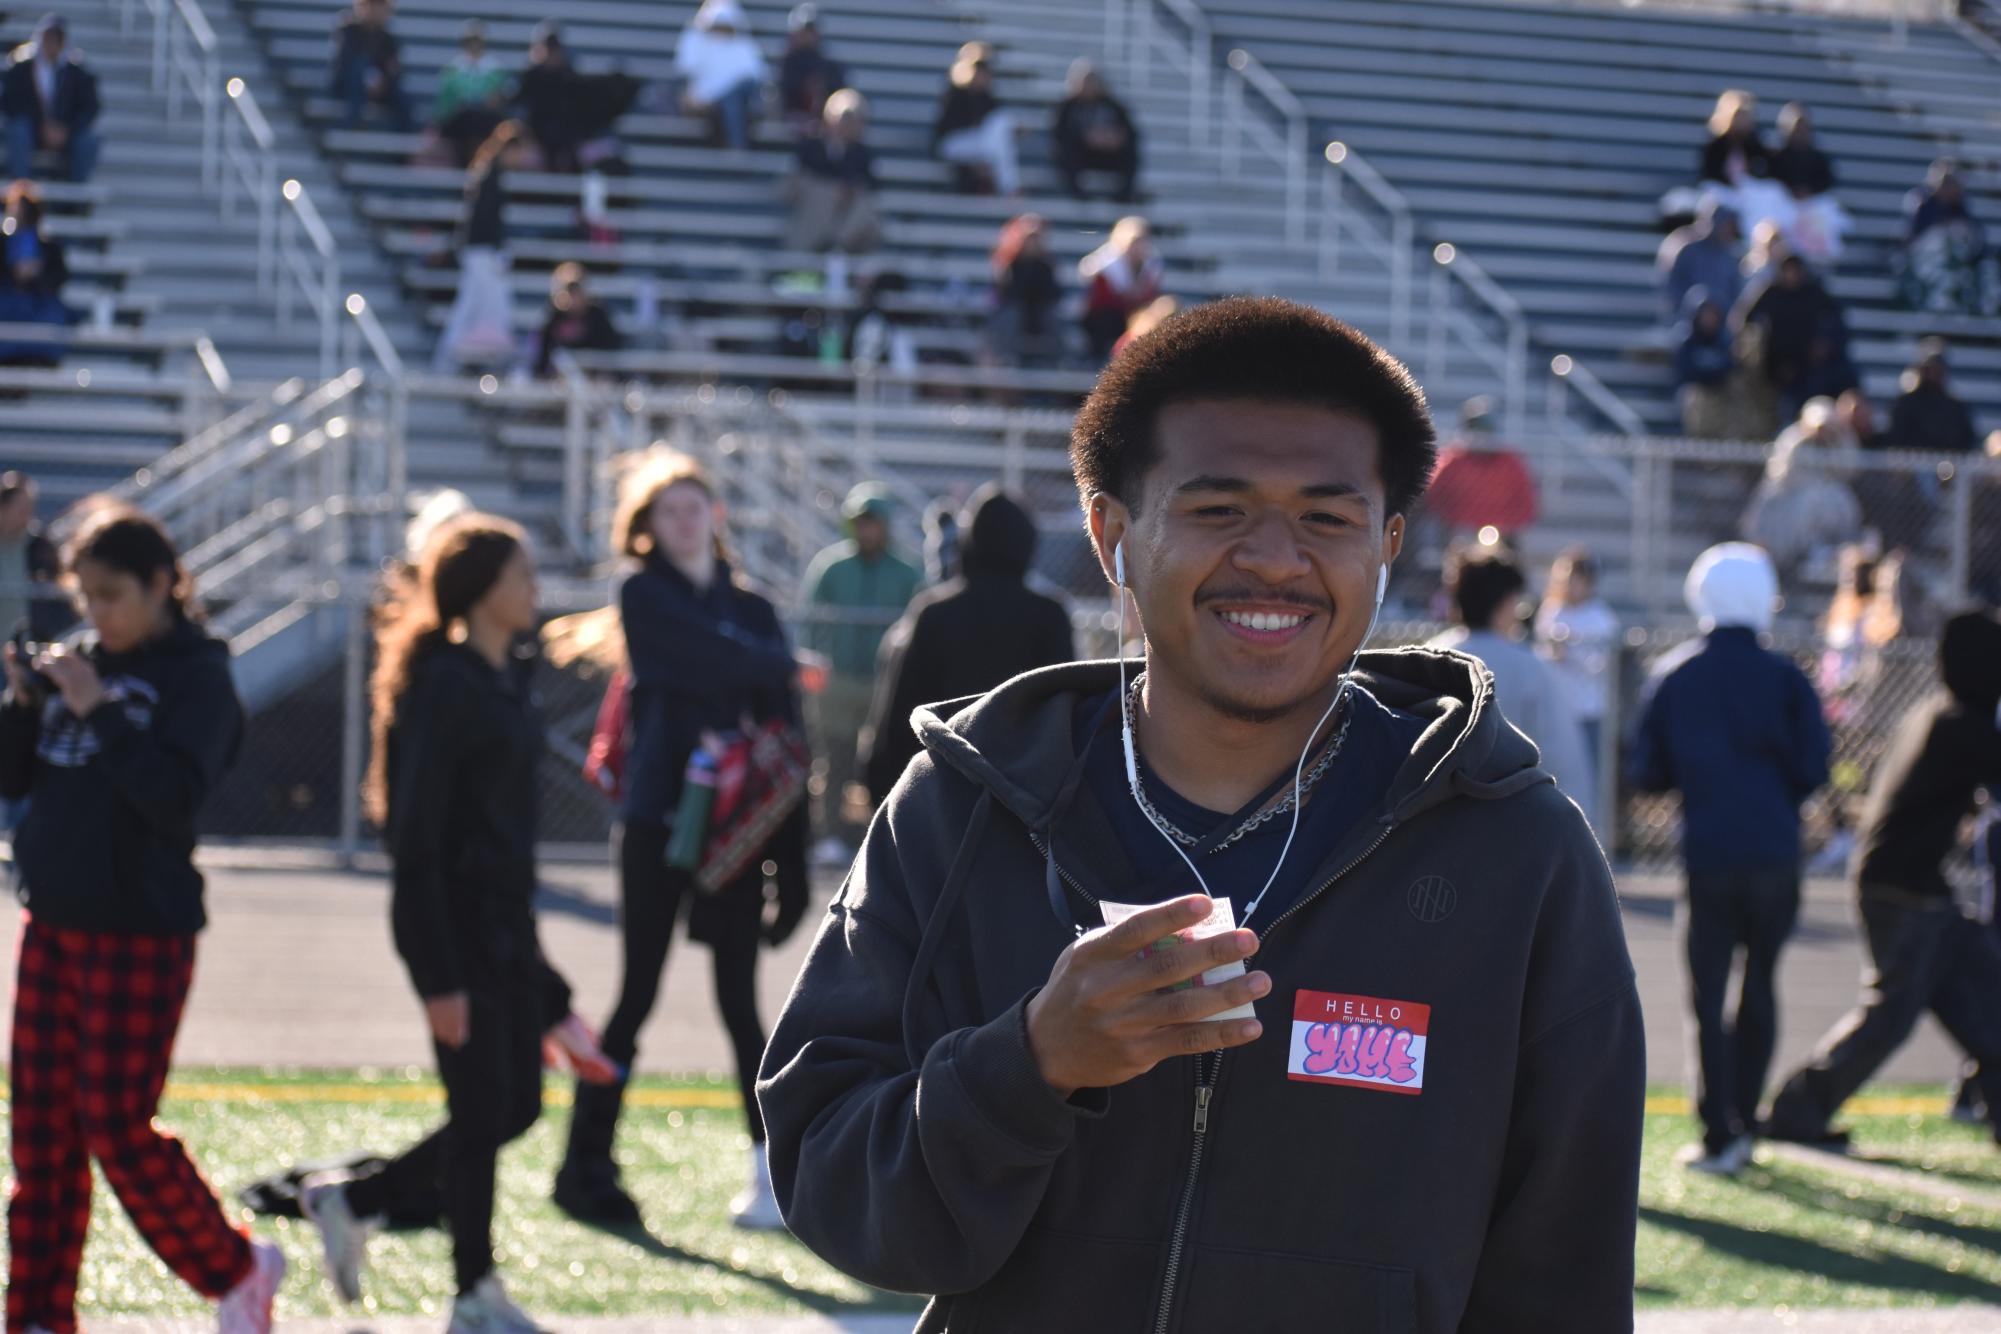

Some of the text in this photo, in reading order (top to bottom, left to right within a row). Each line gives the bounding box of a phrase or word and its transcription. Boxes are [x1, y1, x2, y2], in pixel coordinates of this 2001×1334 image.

[1326, 999, 1401, 1020] HELLO
[1342, 1015, 1354, 1023] my
[1355, 1016, 1375, 1024] name
